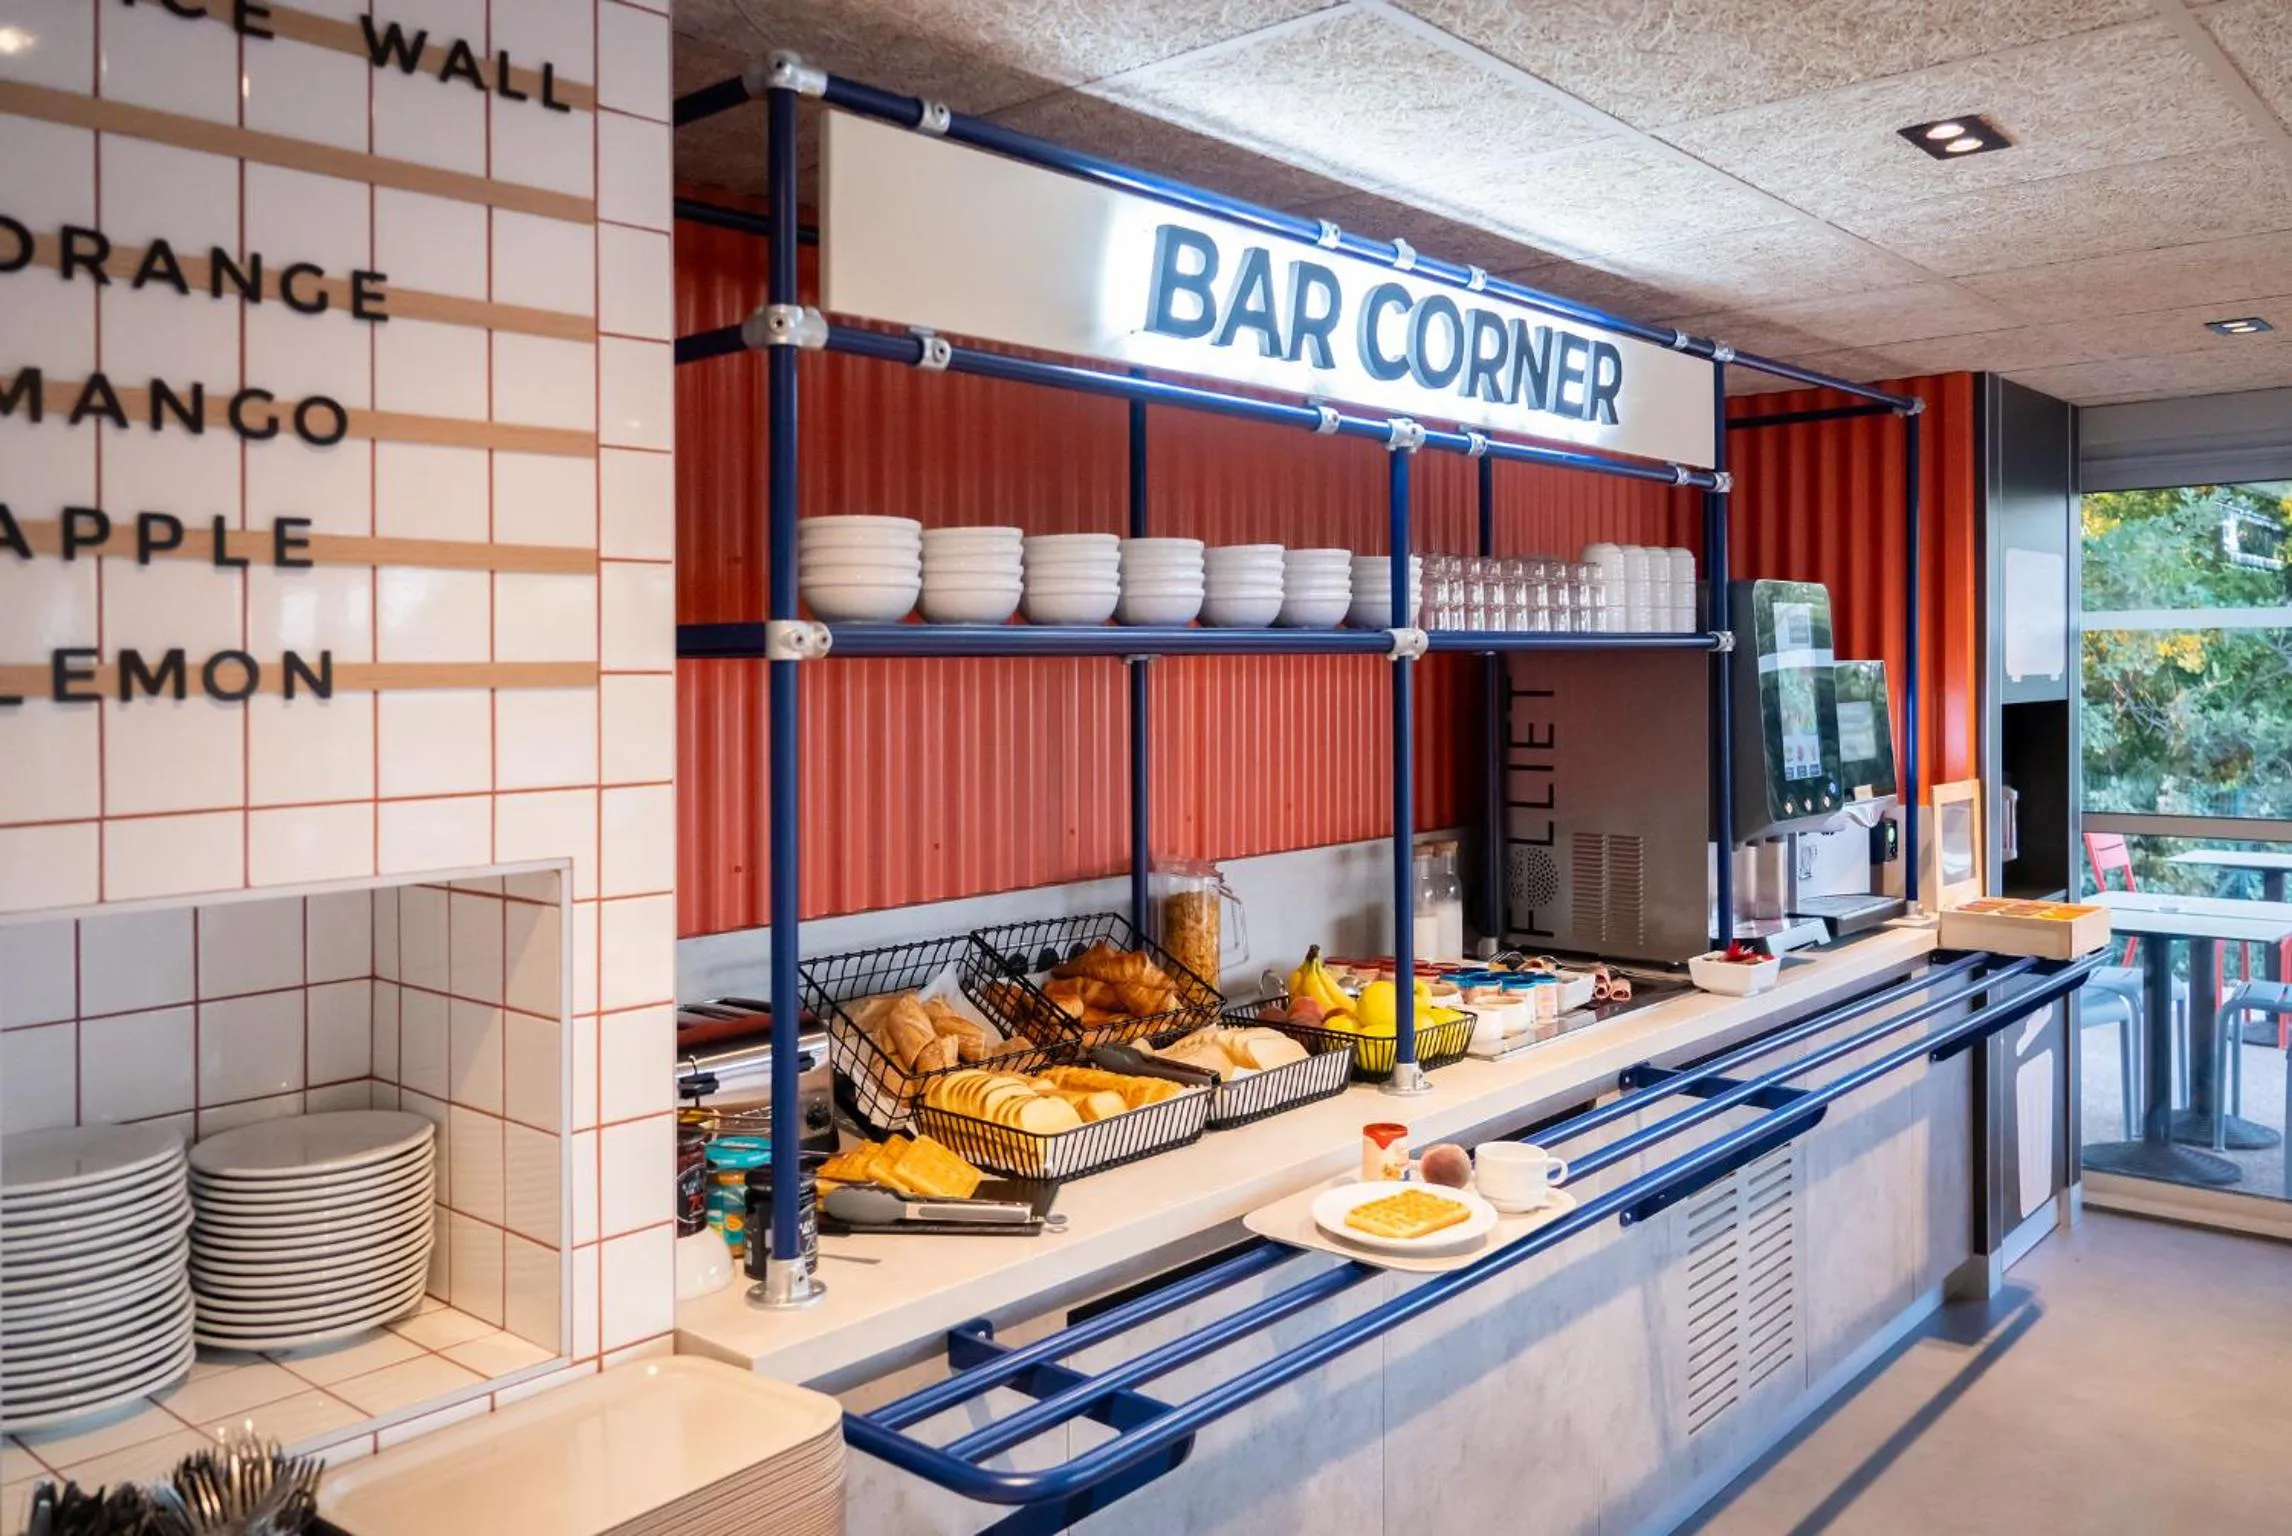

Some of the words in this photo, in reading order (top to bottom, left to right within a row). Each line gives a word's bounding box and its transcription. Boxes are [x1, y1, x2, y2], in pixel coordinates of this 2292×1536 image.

[360, 14, 571, 113] WALL
[1144, 224, 1342, 370] BAR
[1357, 282, 1622, 425] CORNER
